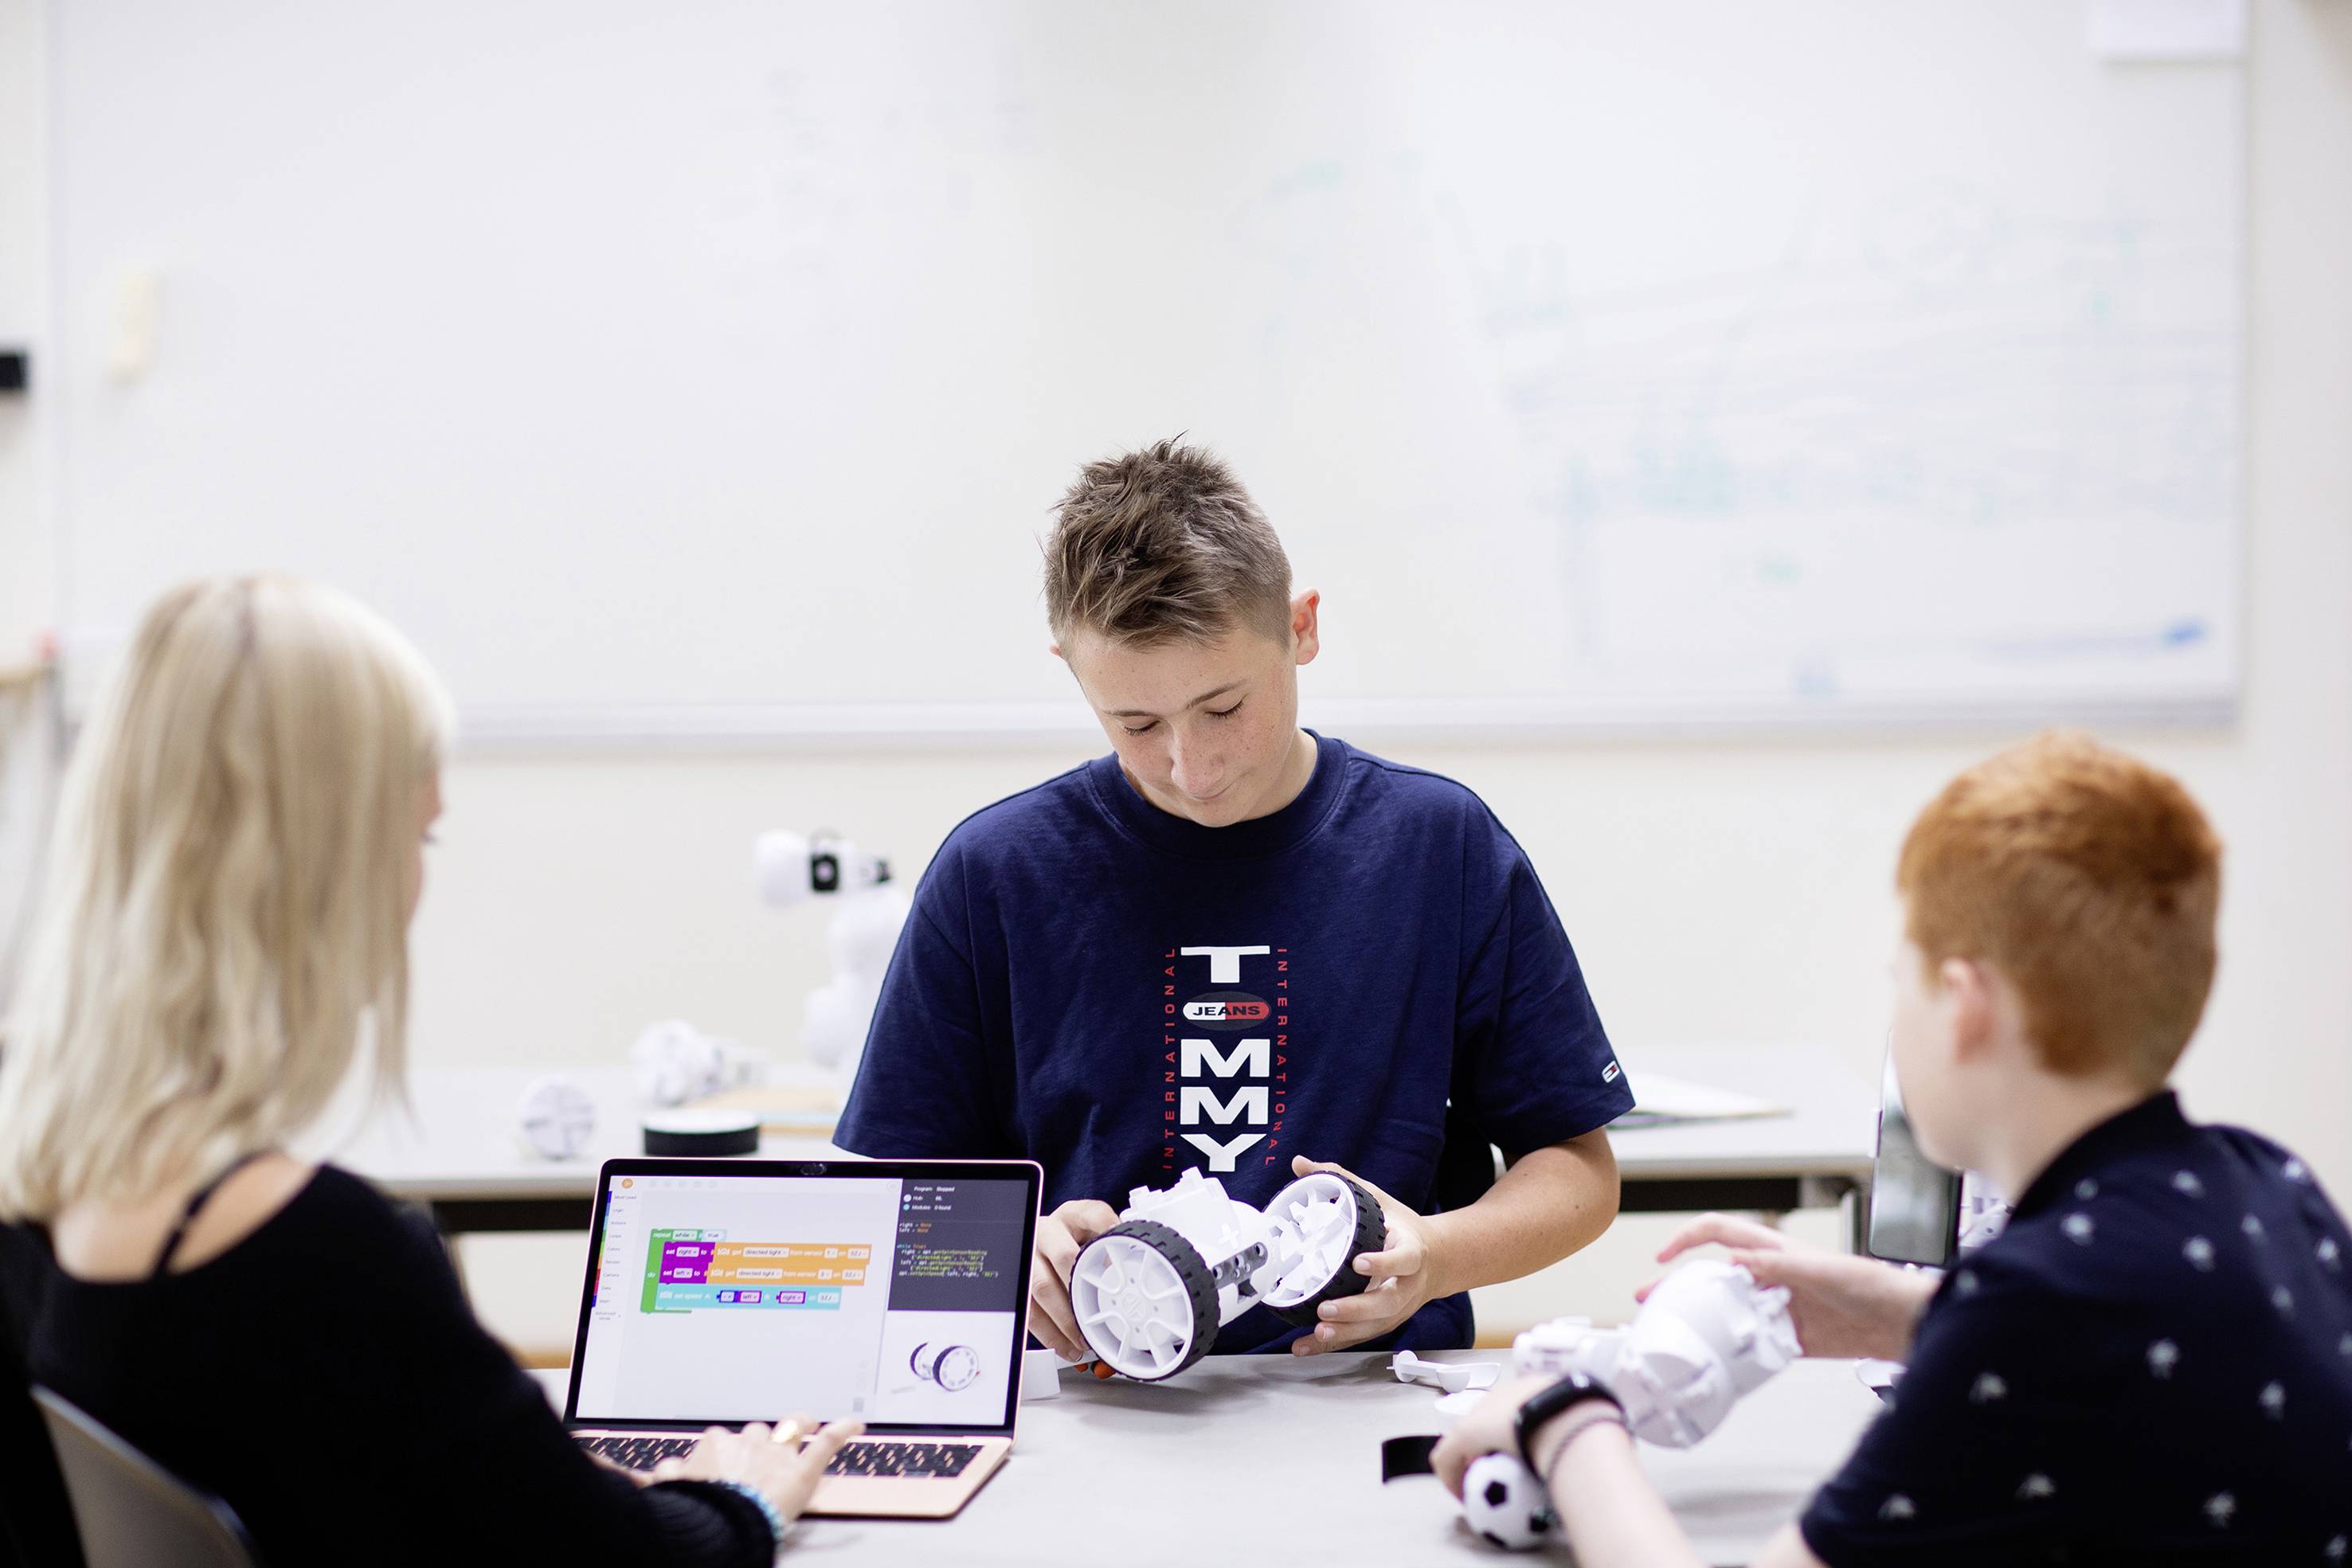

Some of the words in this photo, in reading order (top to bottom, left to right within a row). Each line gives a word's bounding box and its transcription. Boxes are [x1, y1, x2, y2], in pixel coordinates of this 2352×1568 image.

[1162, 948, 1176, 1170] INTERNATIONAL
[1192, 1005, 1261, 1016] JEANS
[1265, 948, 1288, 1166] INTERNATIONAL
